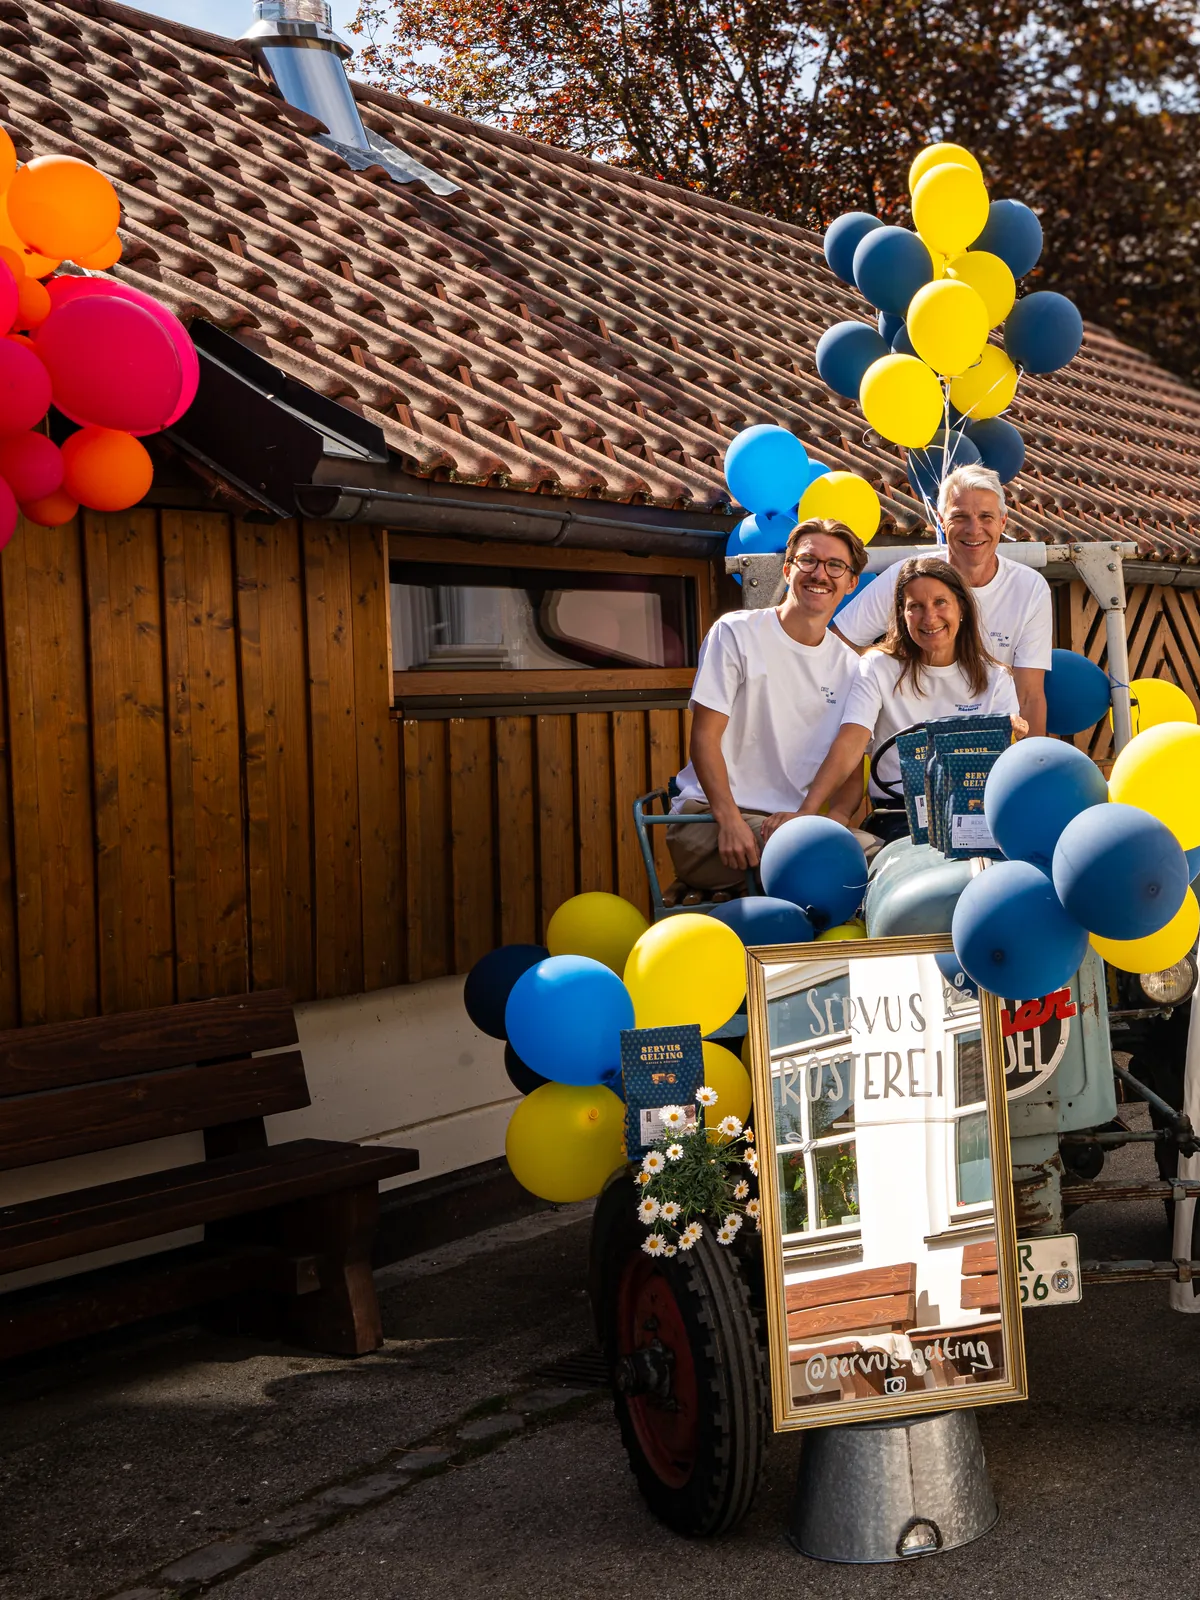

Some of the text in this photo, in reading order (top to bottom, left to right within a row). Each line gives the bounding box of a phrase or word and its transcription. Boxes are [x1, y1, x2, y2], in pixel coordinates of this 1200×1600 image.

[965, 772, 988, 780] SERV
[963, 780, 985, 788] GELT
[806, 988, 927, 1037] SERVUS
[641, 1043, 681, 1053] SERVUS
[640, 1051, 684, 1061] GELTING
[779, 1048, 944, 1106] RÖSTEREI
[805, 1337, 994, 1393] @servus.gelting
